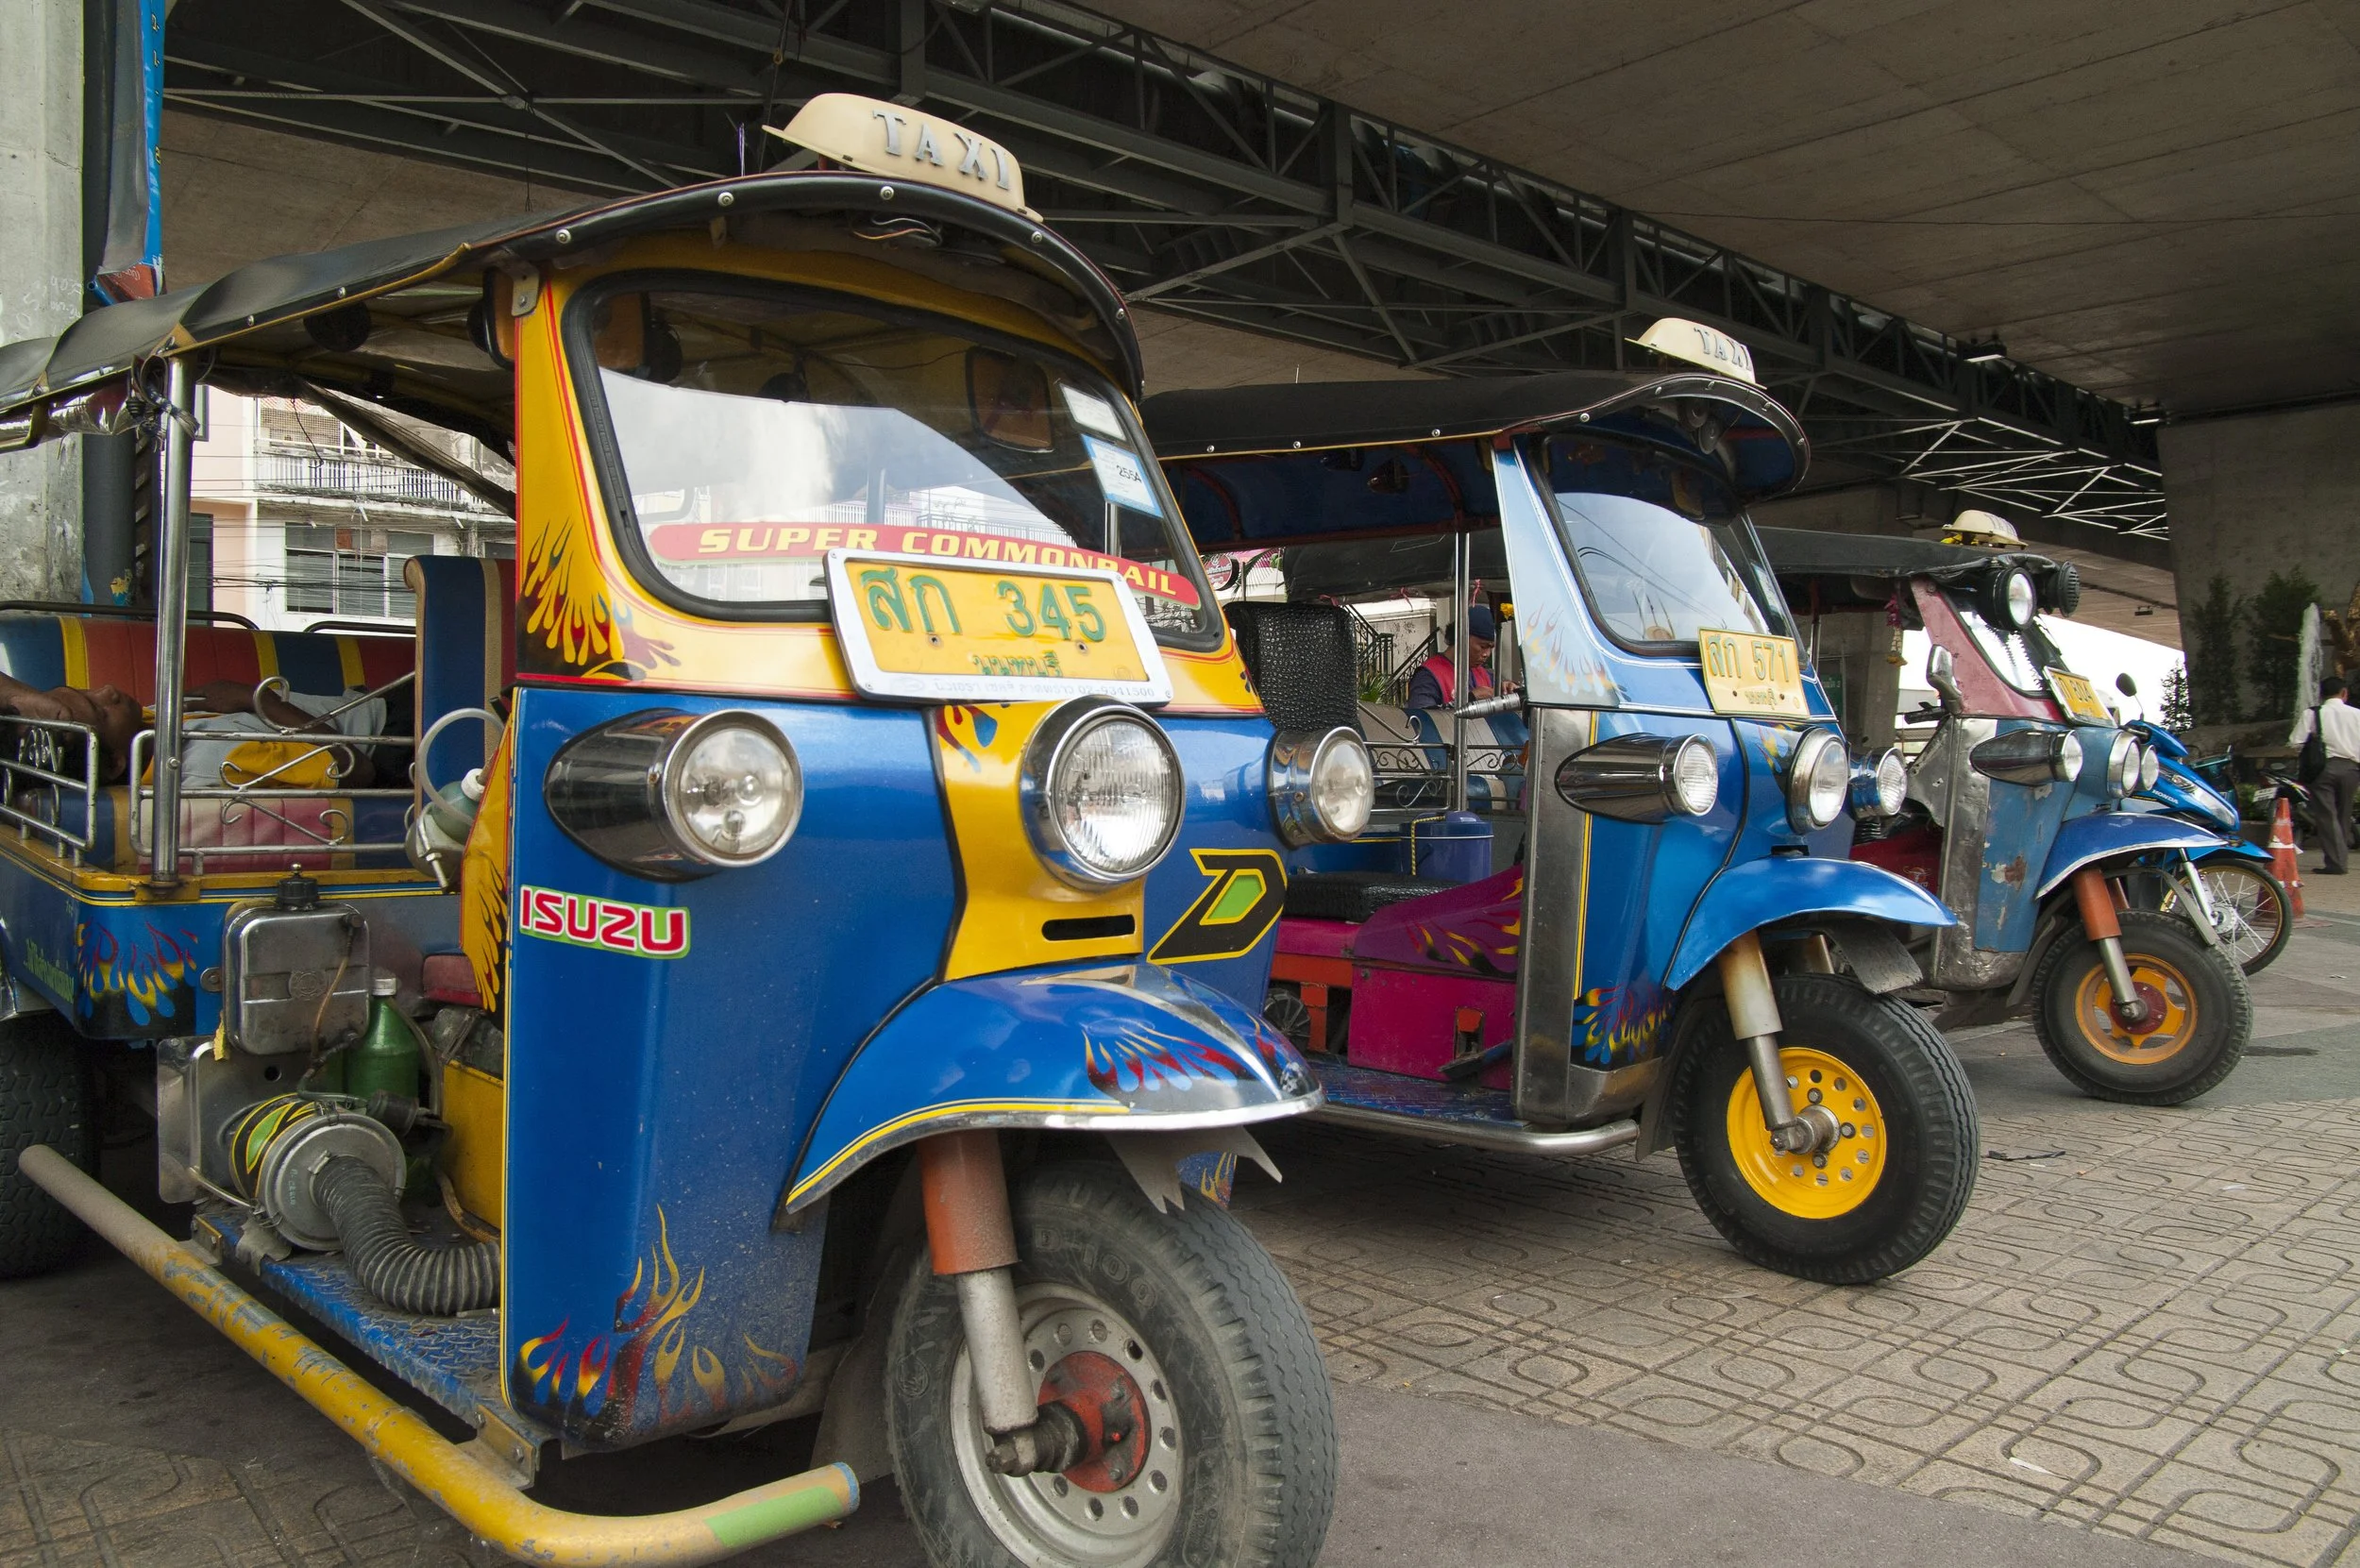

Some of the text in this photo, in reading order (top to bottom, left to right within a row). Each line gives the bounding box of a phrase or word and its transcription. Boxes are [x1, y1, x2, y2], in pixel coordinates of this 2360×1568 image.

[872, 110, 1009, 191] TAXI
[1694, 327, 1752, 371] TAXI
[698, 528, 1177, 596] SUPER COMMONRAIL
[860, 566, 1106, 643] สก 345
[1706, 634, 1790, 683] สก 571
[1078, 683, 1155, 698] 02-9341500
[2152, 789, 2179, 804] HONDA
[520, 885, 687, 954] ISUZU
